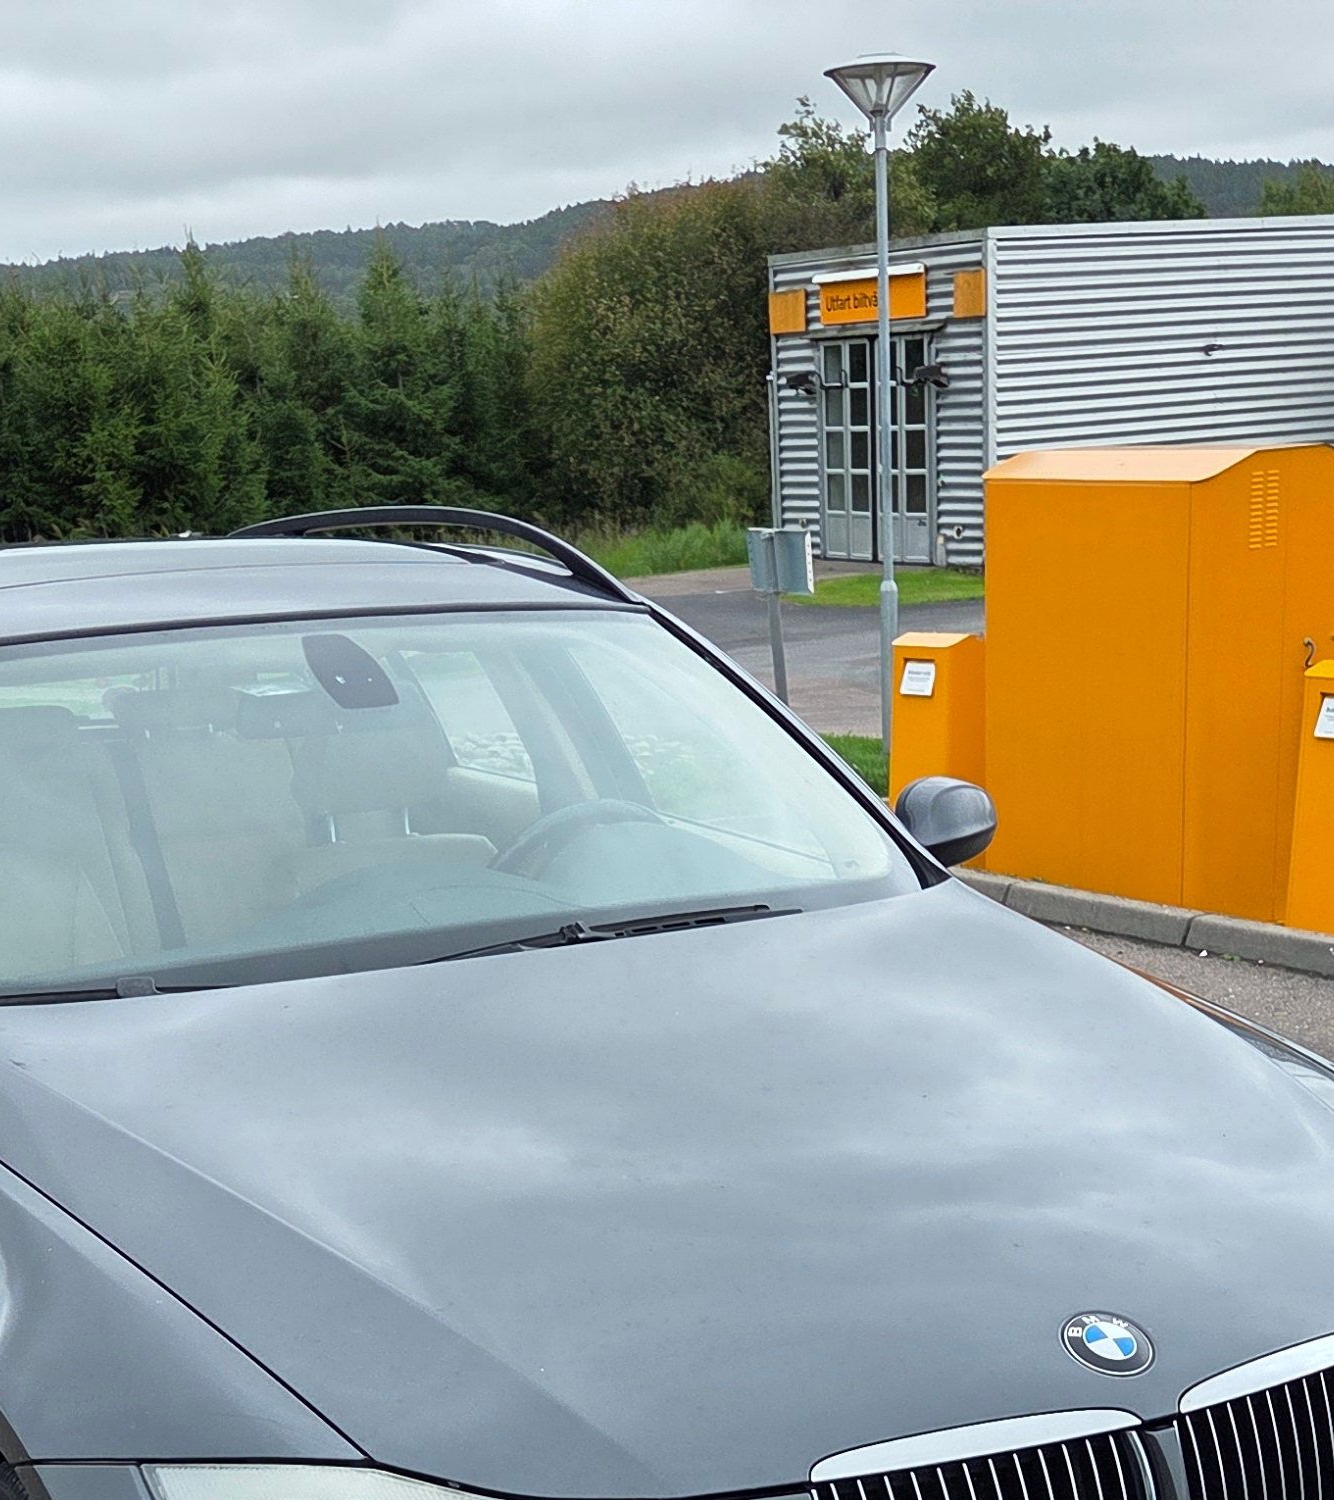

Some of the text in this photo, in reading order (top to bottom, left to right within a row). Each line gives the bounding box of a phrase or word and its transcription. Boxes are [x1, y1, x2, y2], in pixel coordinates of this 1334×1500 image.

[825, 291, 878, 312] Utfart biltvä
[1068, 1315, 1129, 1337] BMW
